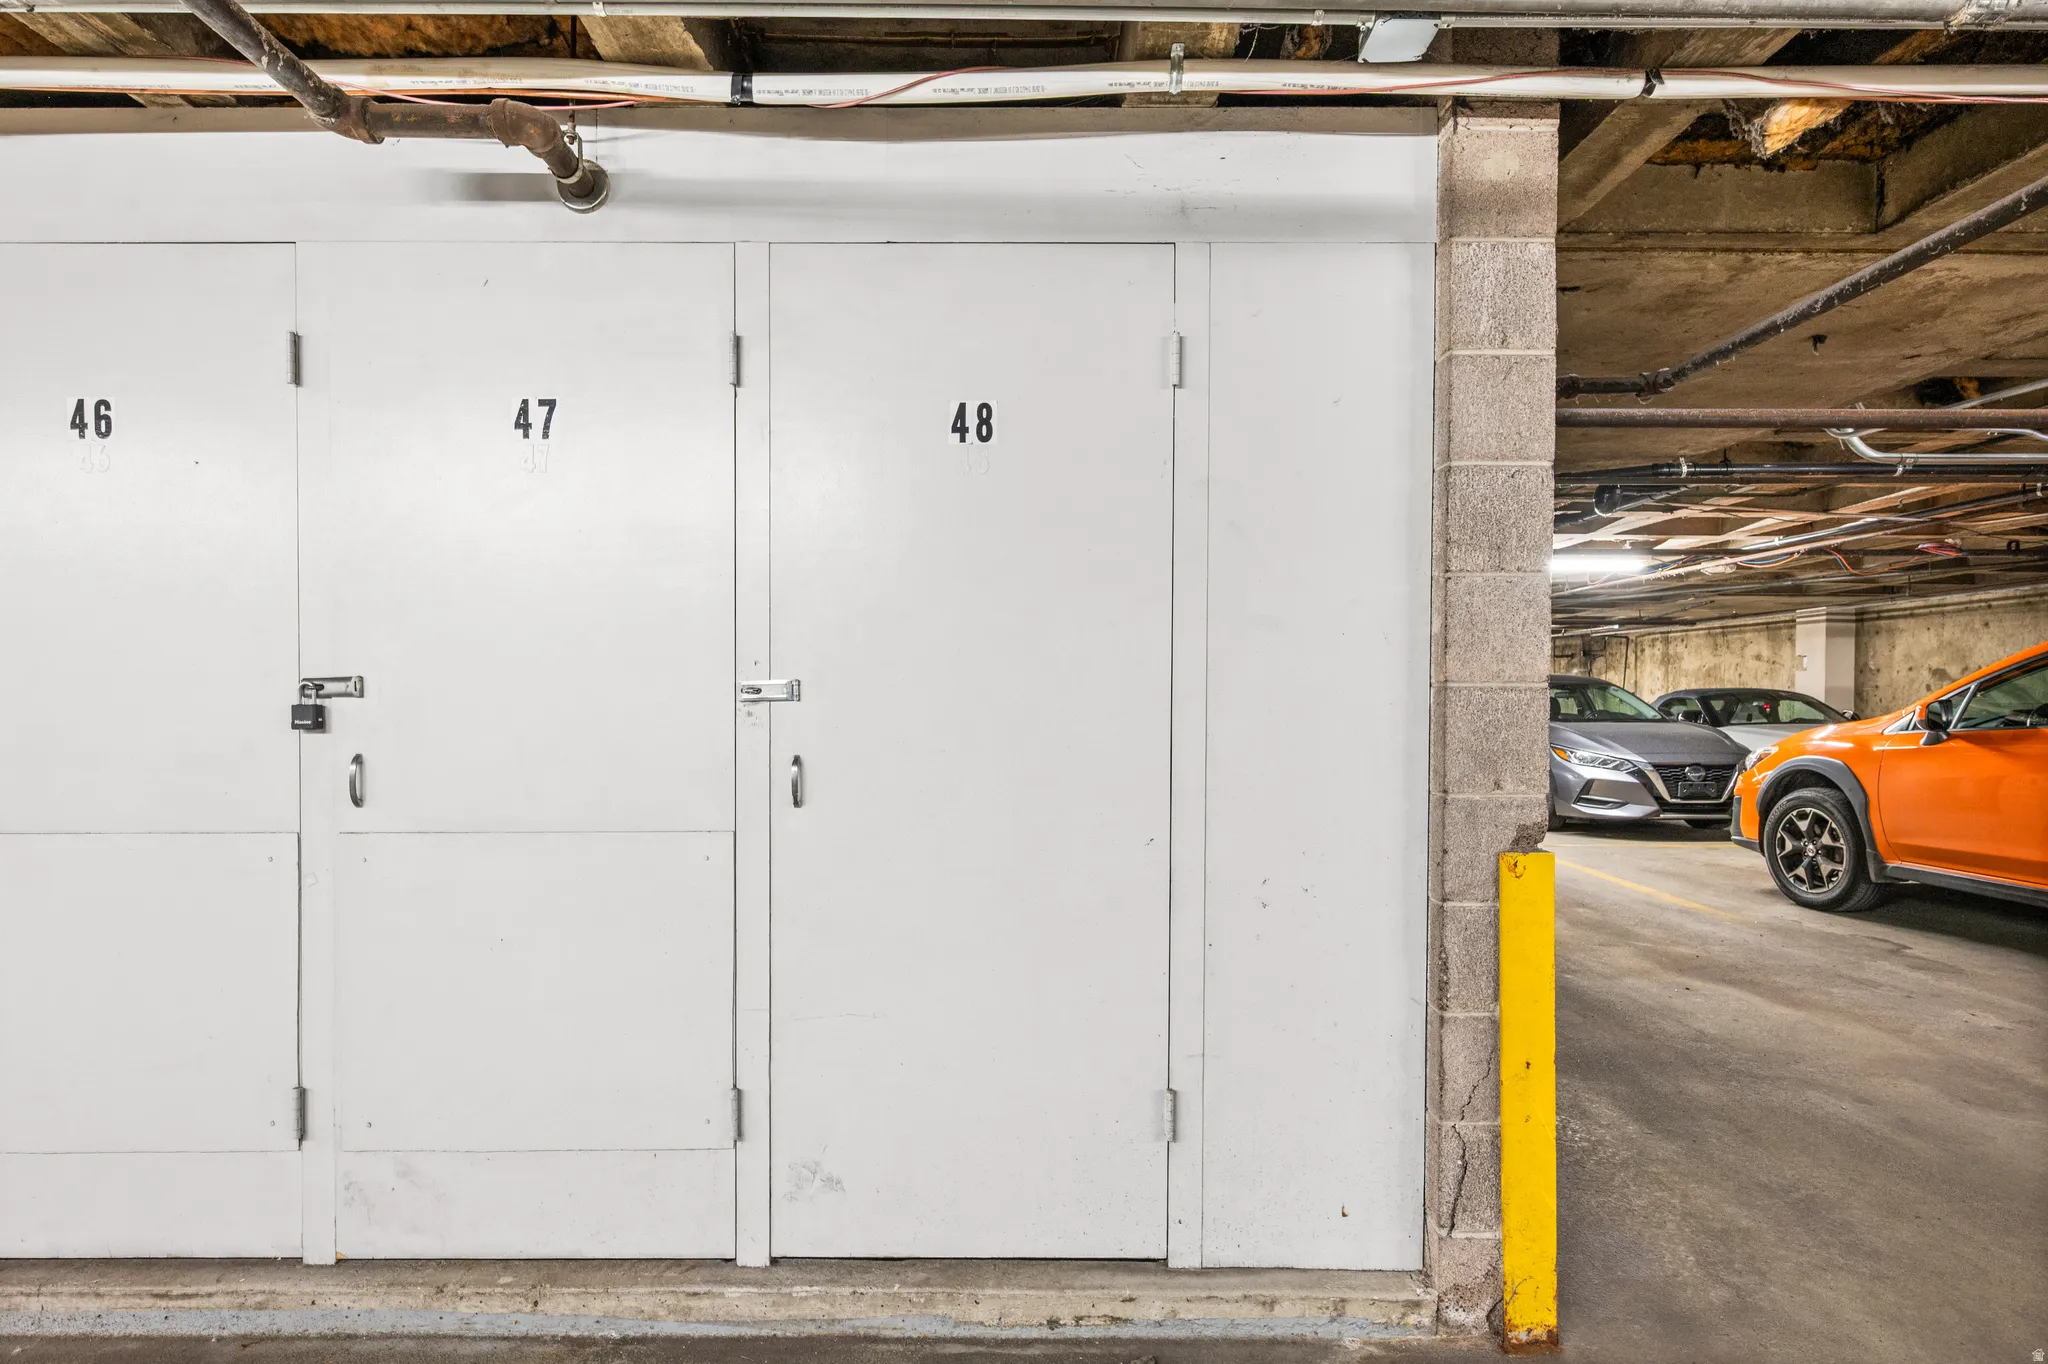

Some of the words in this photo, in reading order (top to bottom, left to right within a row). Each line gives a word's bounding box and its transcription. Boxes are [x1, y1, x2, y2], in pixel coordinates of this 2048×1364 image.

[70, 398, 112, 440] 46
[514, 398, 557, 440] 47
[951, 402, 993, 443] 48
